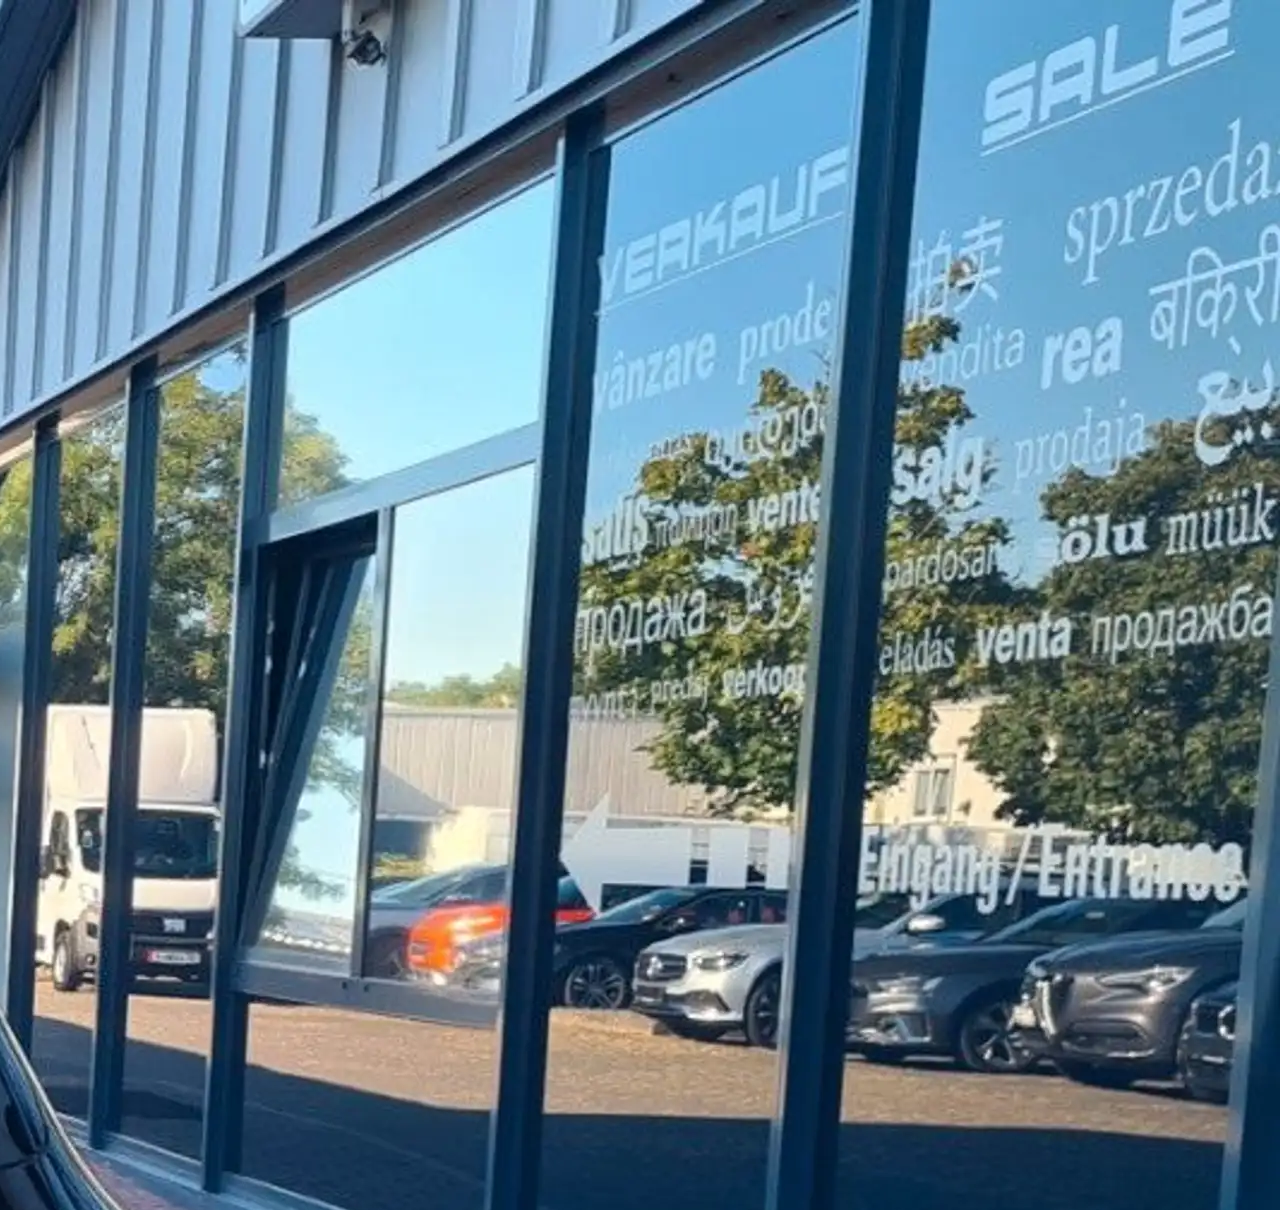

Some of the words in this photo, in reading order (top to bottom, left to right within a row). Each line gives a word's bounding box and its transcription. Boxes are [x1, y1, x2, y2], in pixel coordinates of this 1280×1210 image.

[981, 0, 1233, 146] SALE
[597, 146, 849, 302] VERKAUF
[1064, 118, 1280, 286] sprzeda
[1040, 316, 1123, 390] rea
[1013, 396, 1146, 496] prodaja
[1048, 513, 1149, 567] ölu
[1164, 482, 1277, 556] müük
[574, 587, 709, 670] продажа
[977, 608, 1071, 668] venta
[1091, 582, 1273, 666] продажба
[856, 823, 1002, 914] Eingang
